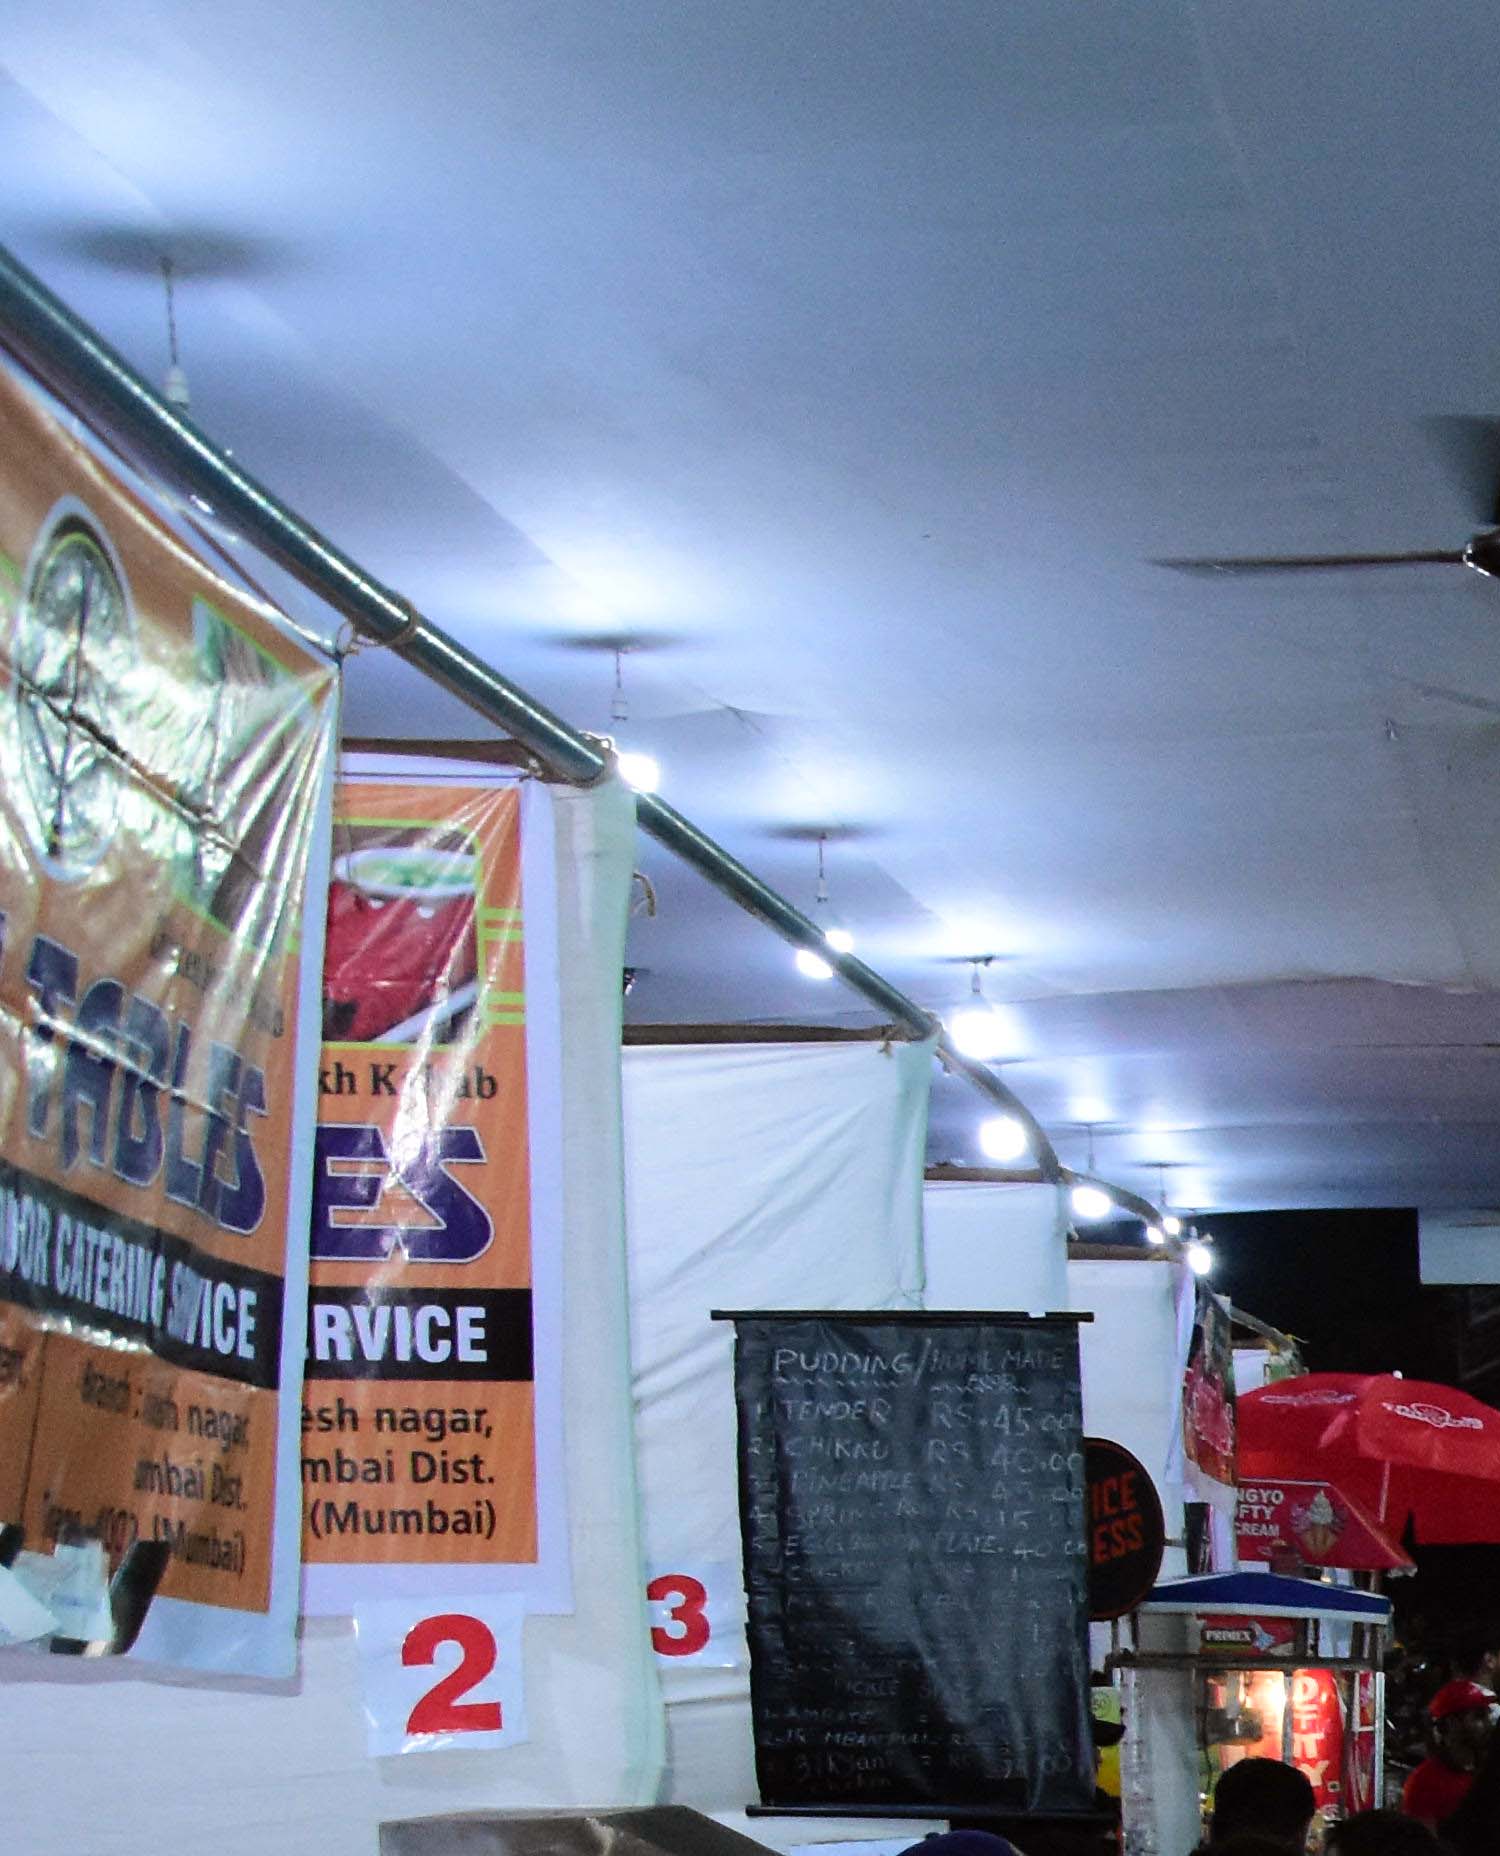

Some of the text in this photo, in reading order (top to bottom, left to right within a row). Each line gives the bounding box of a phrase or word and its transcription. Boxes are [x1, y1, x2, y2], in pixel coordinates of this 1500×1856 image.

[54, 1213, 167, 1328] CATERING
[375, 1407, 493, 1442] nagar,
[411, 1450, 494, 1485] Dist.
[311, 1498, 497, 1540] (Mumbai)
[646, 1574, 711, 1657] 3
[402, 1613, 503, 1736] 2
